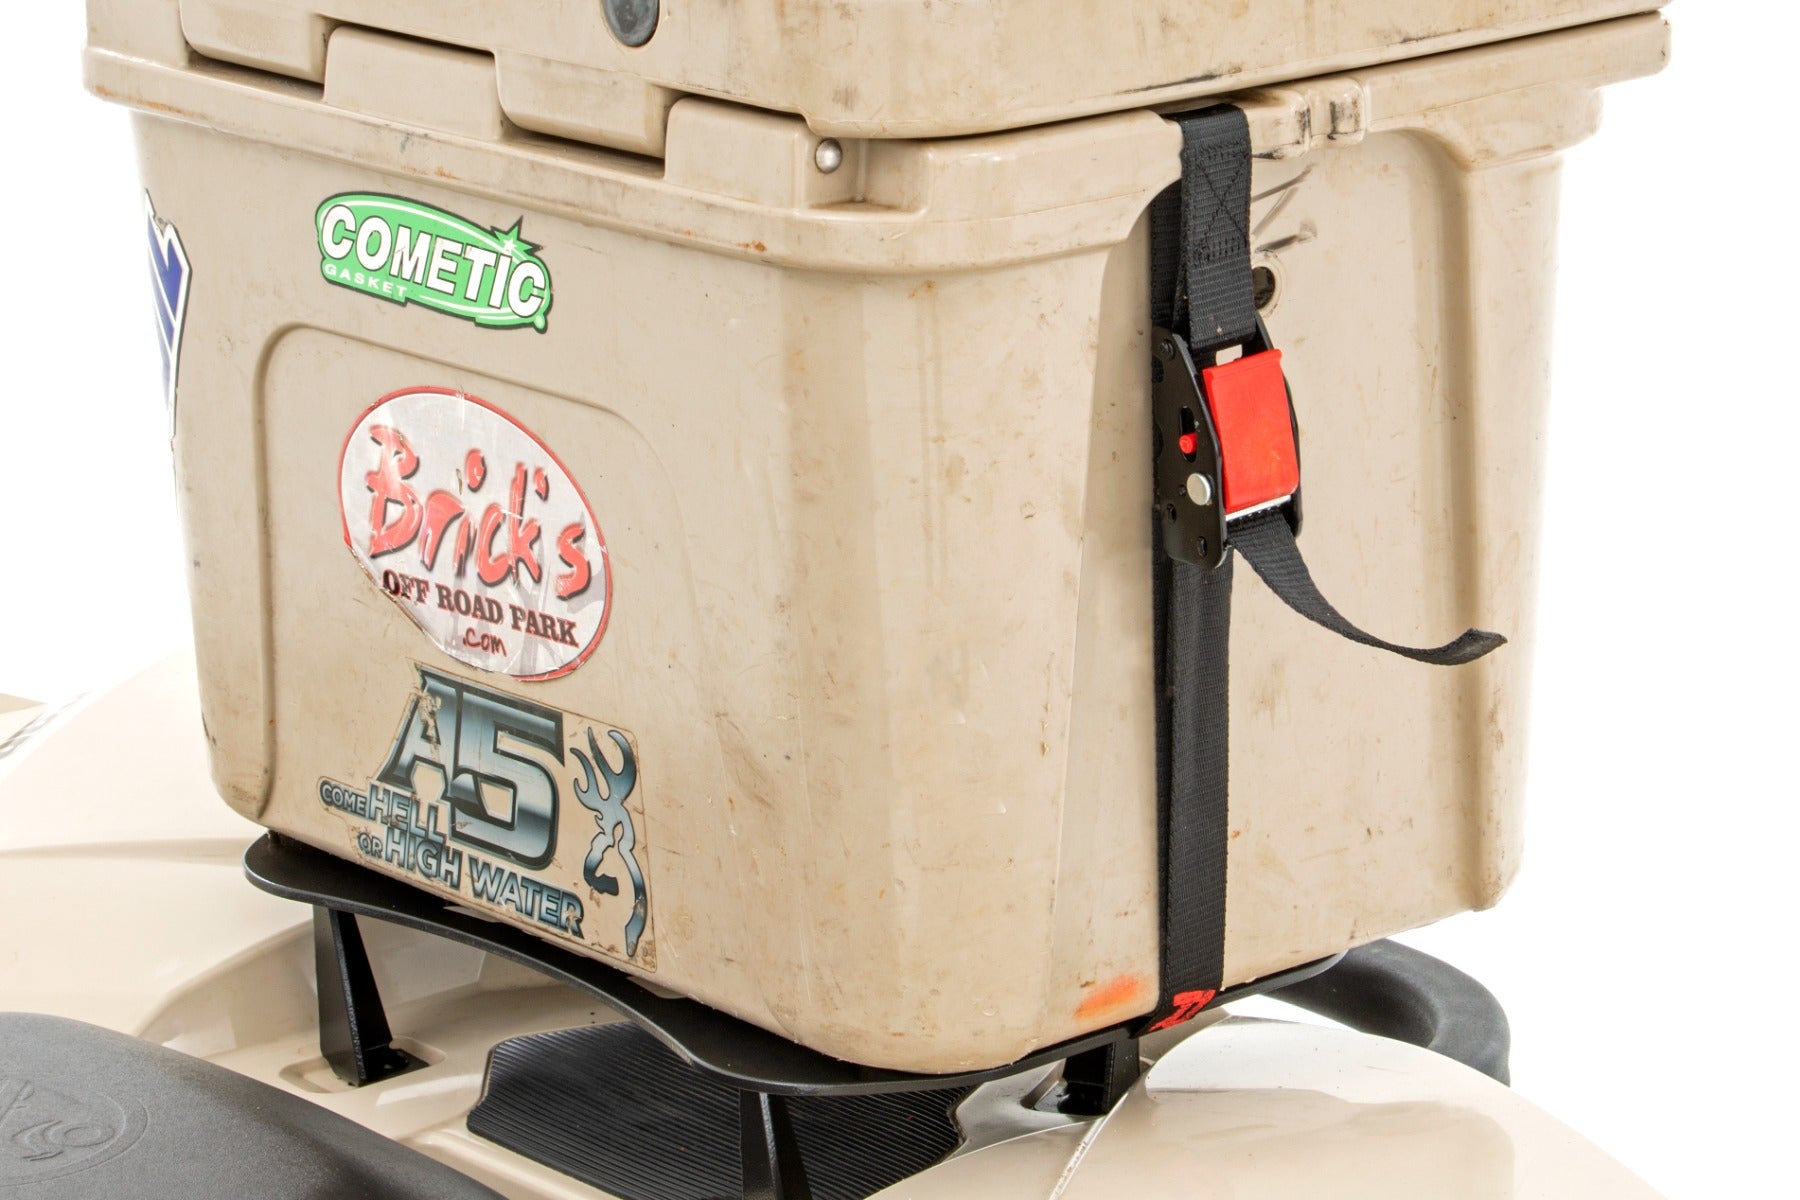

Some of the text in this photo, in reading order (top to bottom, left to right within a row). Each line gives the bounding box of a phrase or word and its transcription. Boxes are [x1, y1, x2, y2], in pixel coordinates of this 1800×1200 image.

[322, 204, 546, 318] COMETIC
[324, 263, 408, 297] GASKET
[366, 424, 592, 600] Brick's
[382, 569, 579, 648] OFF ROAD PARK
[320, 781, 447, 843] COME HELL
[377, 670, 566, 871] A5
[357, 828, 585, 939] OR HIGH WATER
